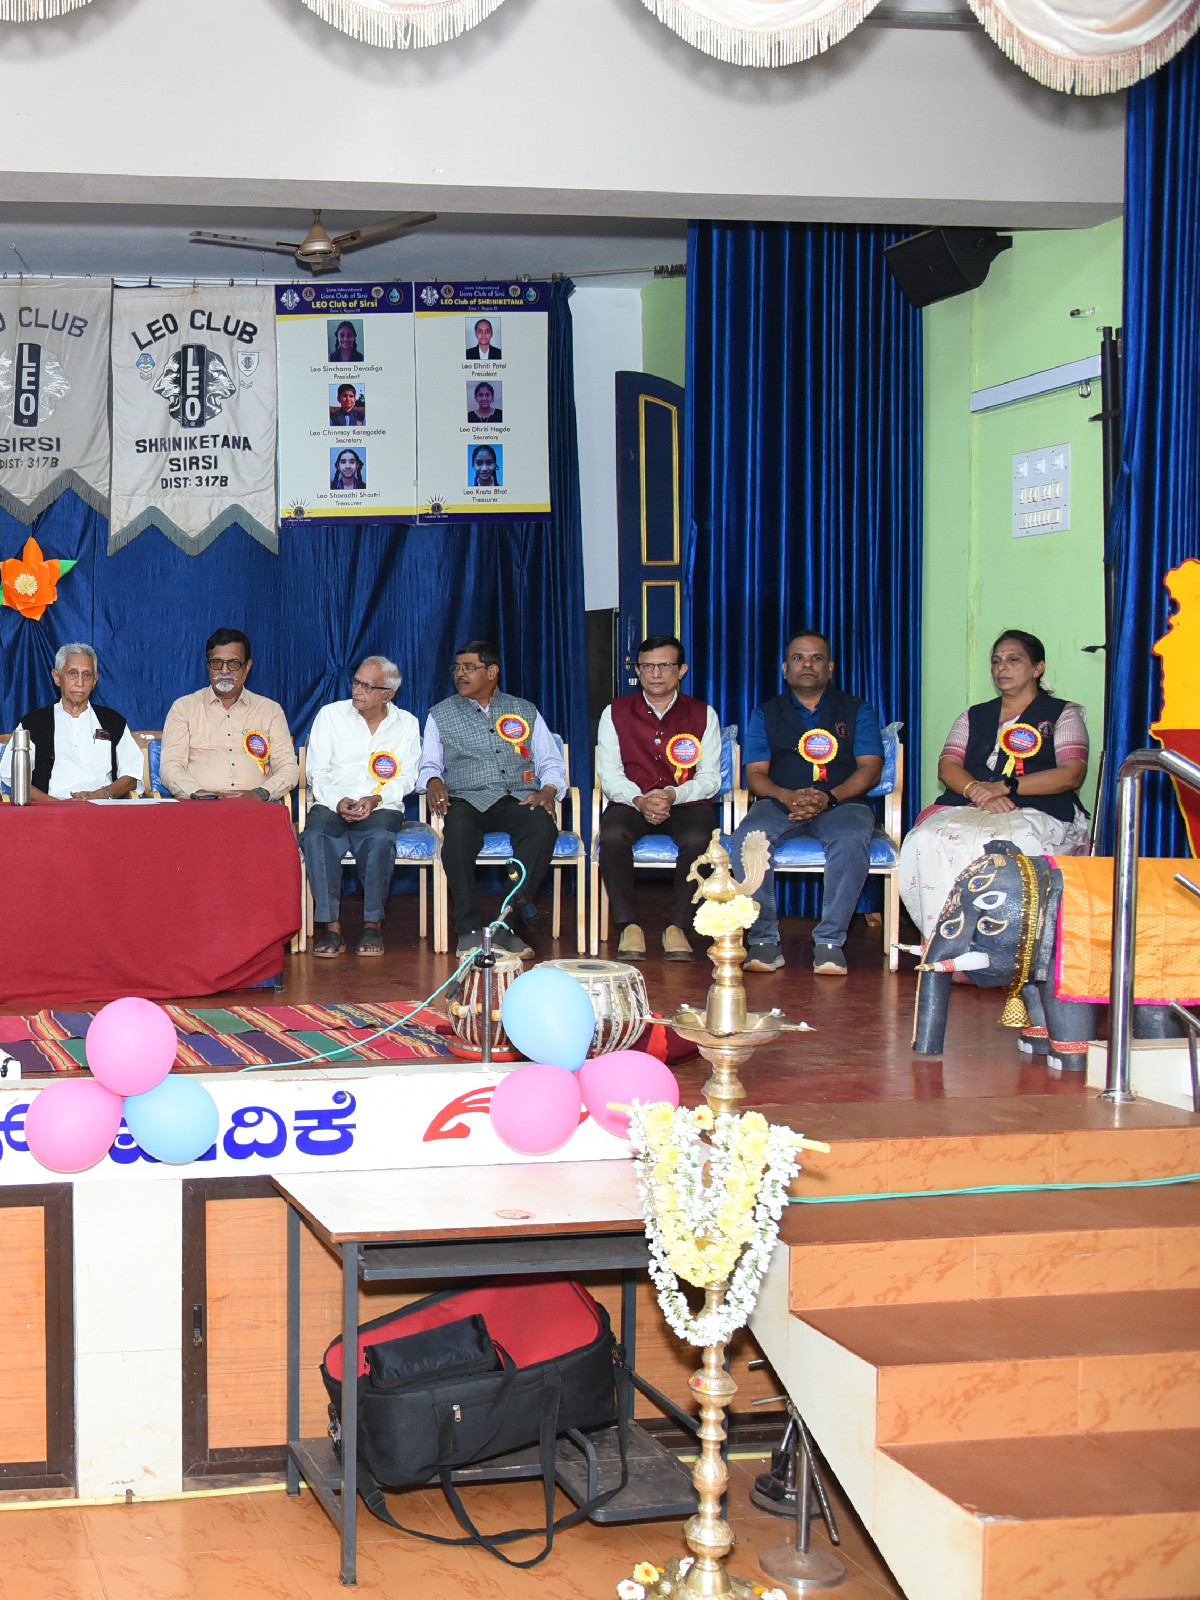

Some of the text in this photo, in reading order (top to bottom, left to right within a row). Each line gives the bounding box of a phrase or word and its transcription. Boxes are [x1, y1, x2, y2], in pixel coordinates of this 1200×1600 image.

[311, 299, 378, 309] LEO Club of Sirsi
[477, 298, 524, 306] SHRINIKETANA
[18, 306, 89, 338] CLUB
[131, 309, 258, 351] LEO CLUB
[19, 344, 37, 416] LEO
[184, 347, 201, 421] LEO
[135, 434, 252, 454] SHRINIKETANA
[0, 457, 60, 470] DIST: 317B
[168, 455, 219, 472] SIRSI
[161, 475, 229, 489] DIST: 317B
